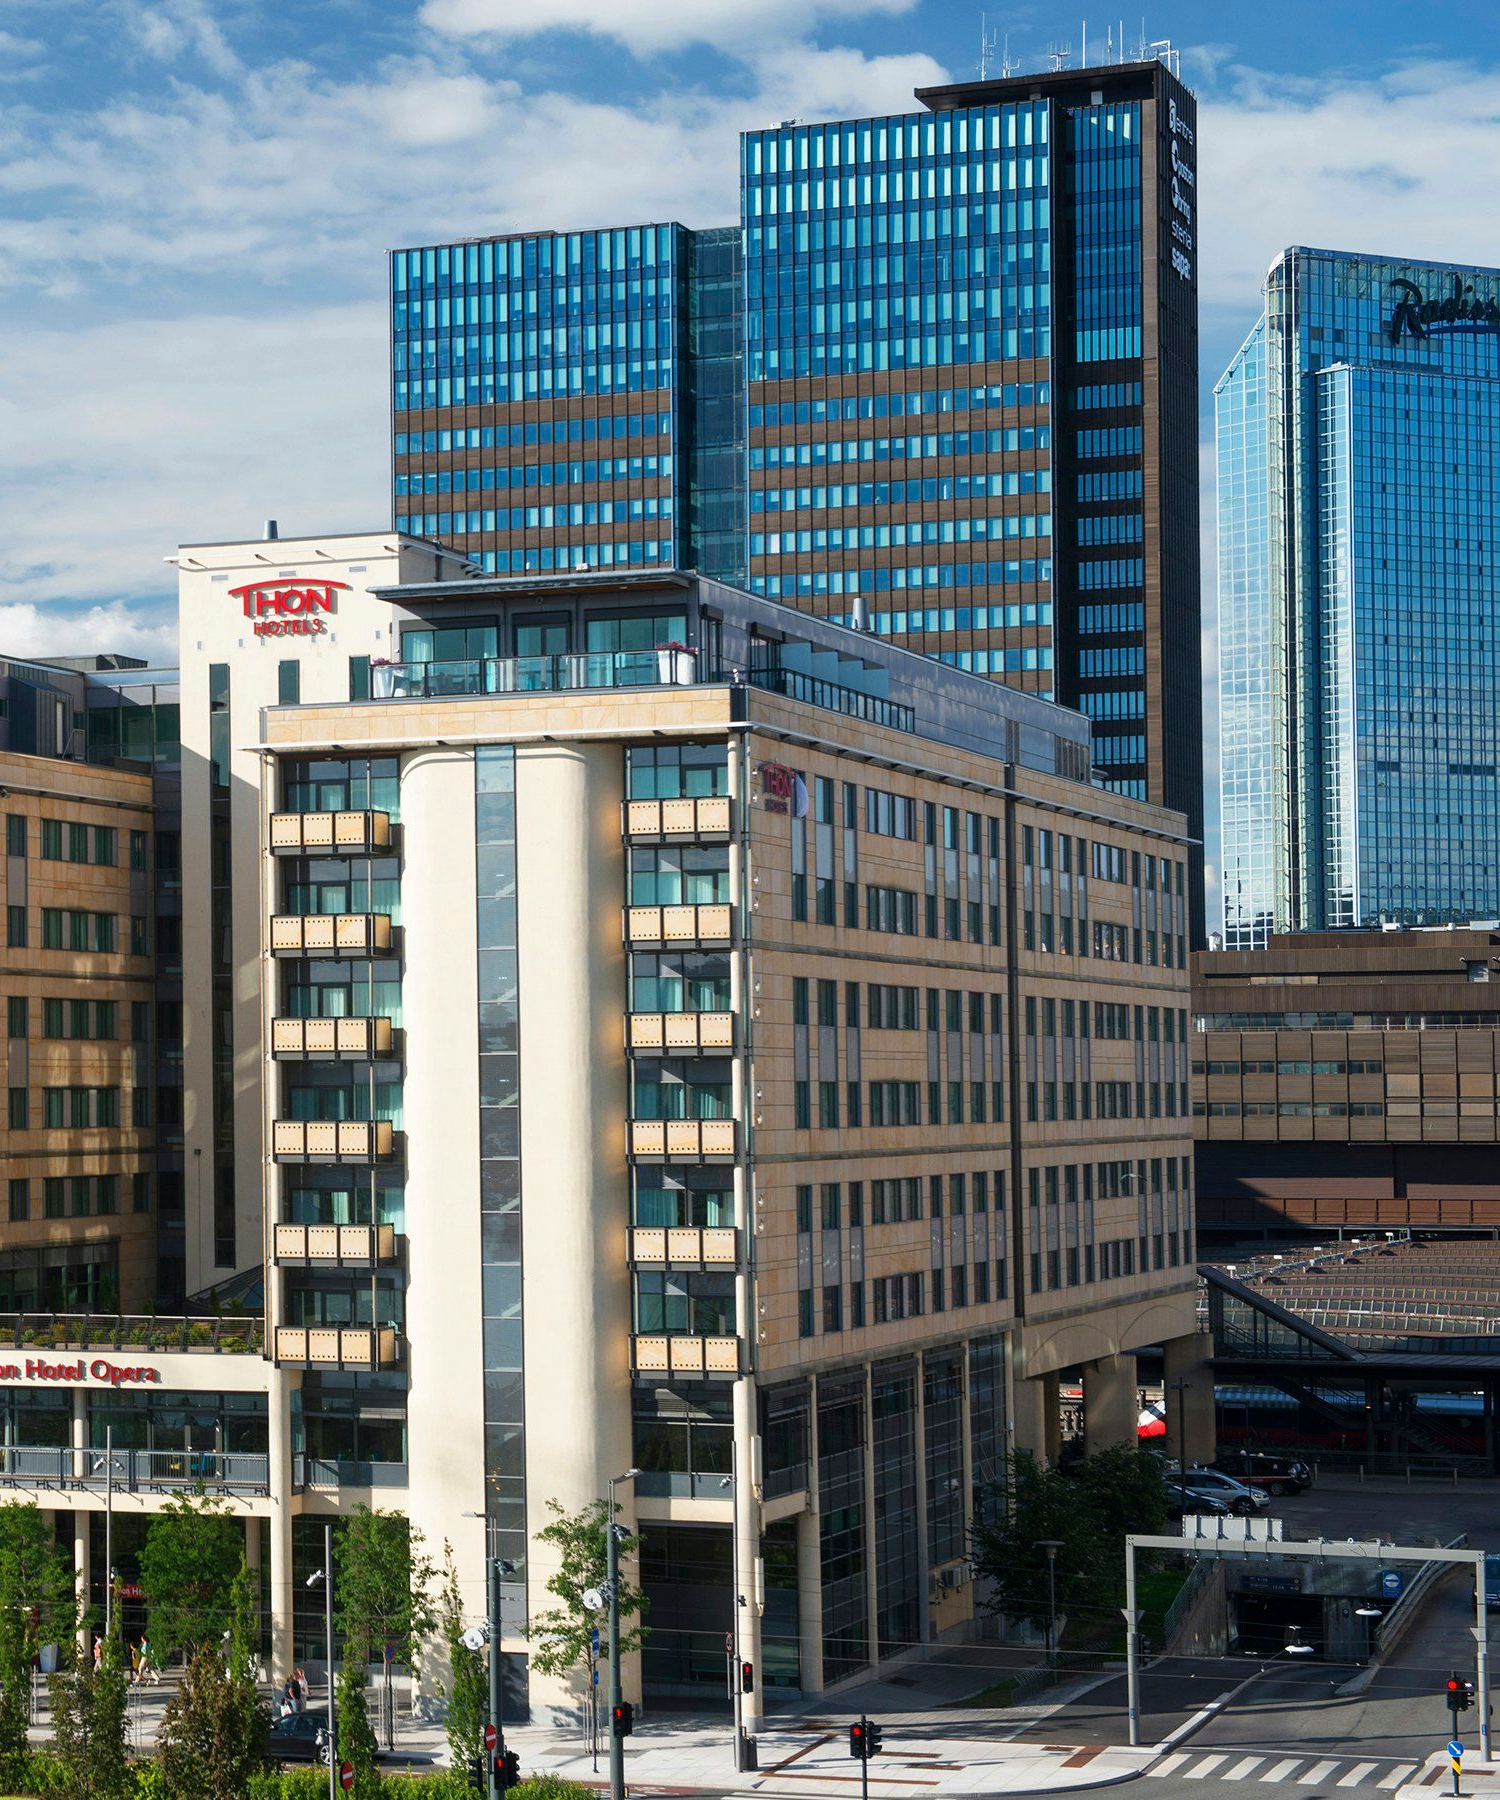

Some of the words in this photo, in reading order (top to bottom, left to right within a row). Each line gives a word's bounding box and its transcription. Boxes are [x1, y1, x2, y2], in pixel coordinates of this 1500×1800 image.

[1171, 219, 1192, 251] steria
[227, 578, 349, 616] THON
[253, 618, 322, 635] HOTELS
[763, 763, 797, 798] THON
[25, 1358, 82, 1380] Hotel
[90, 1359, 157, 1386] Opera
